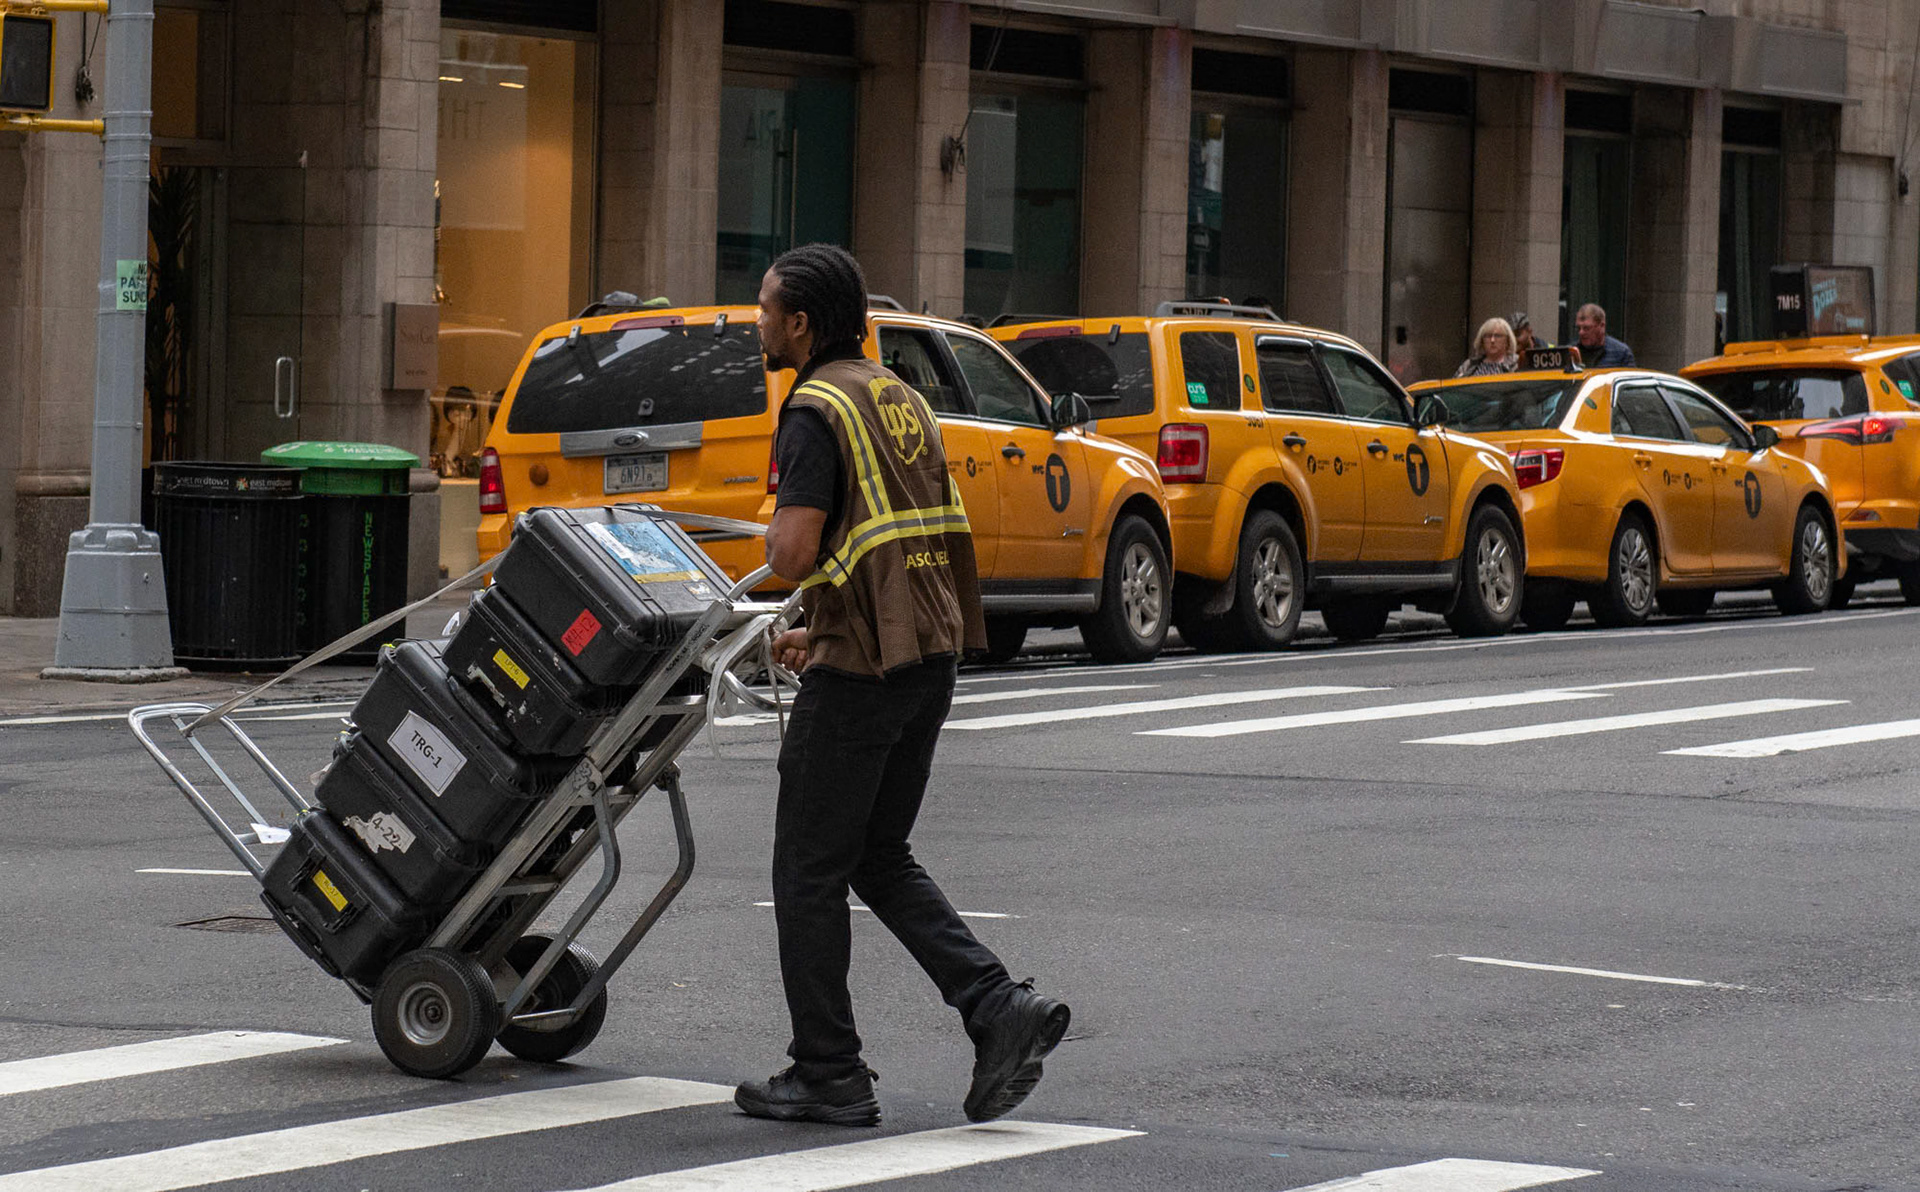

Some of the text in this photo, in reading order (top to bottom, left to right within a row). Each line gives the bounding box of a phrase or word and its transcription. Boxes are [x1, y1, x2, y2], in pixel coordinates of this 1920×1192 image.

[1777, 295, 1800, 311] 7M15
[1533, 352, 1562, 368] 9C30
[877, 402, 919, 450] ups
[410, 730, 442, 768] TRG-1
